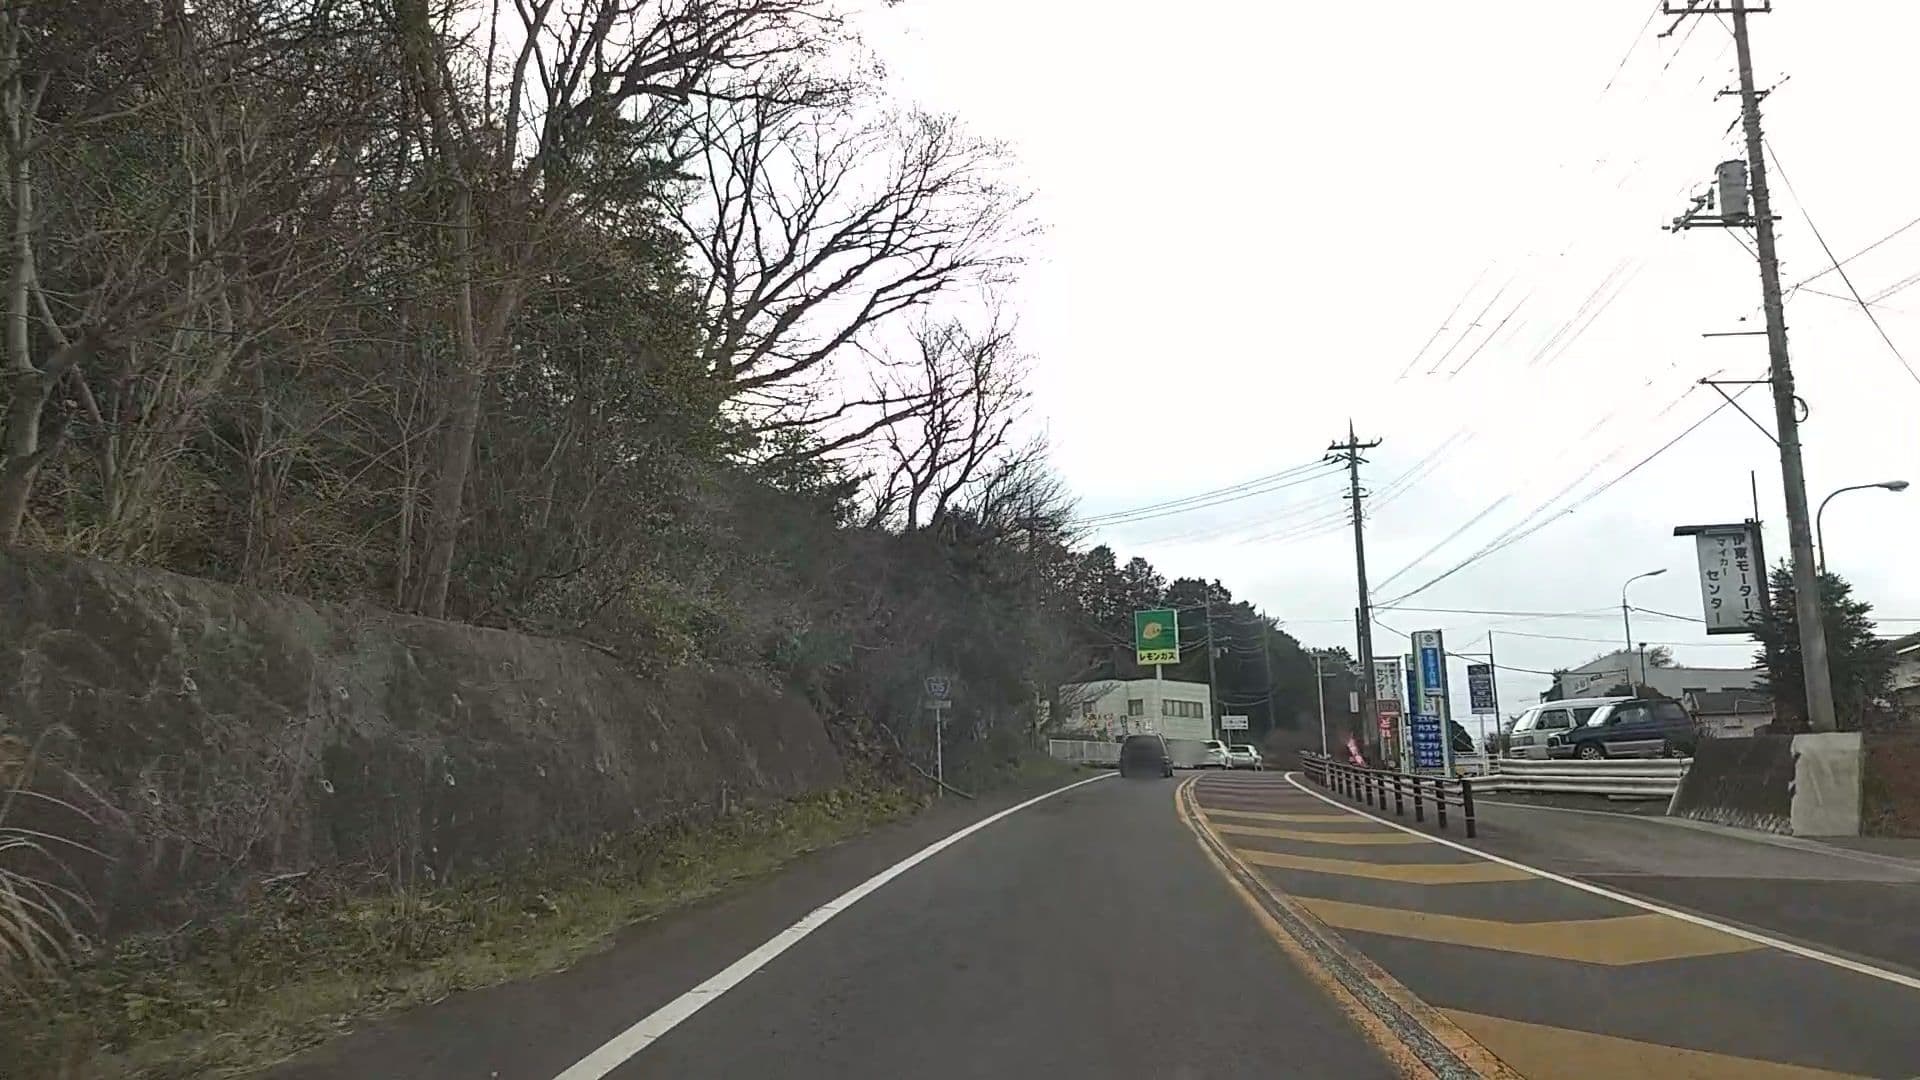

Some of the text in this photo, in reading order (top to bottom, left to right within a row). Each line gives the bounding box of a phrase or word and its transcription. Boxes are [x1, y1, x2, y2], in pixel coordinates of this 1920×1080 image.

[1705, 570, 1723, 624] センター
[1139, 652, 1176, 661] レモンガス
